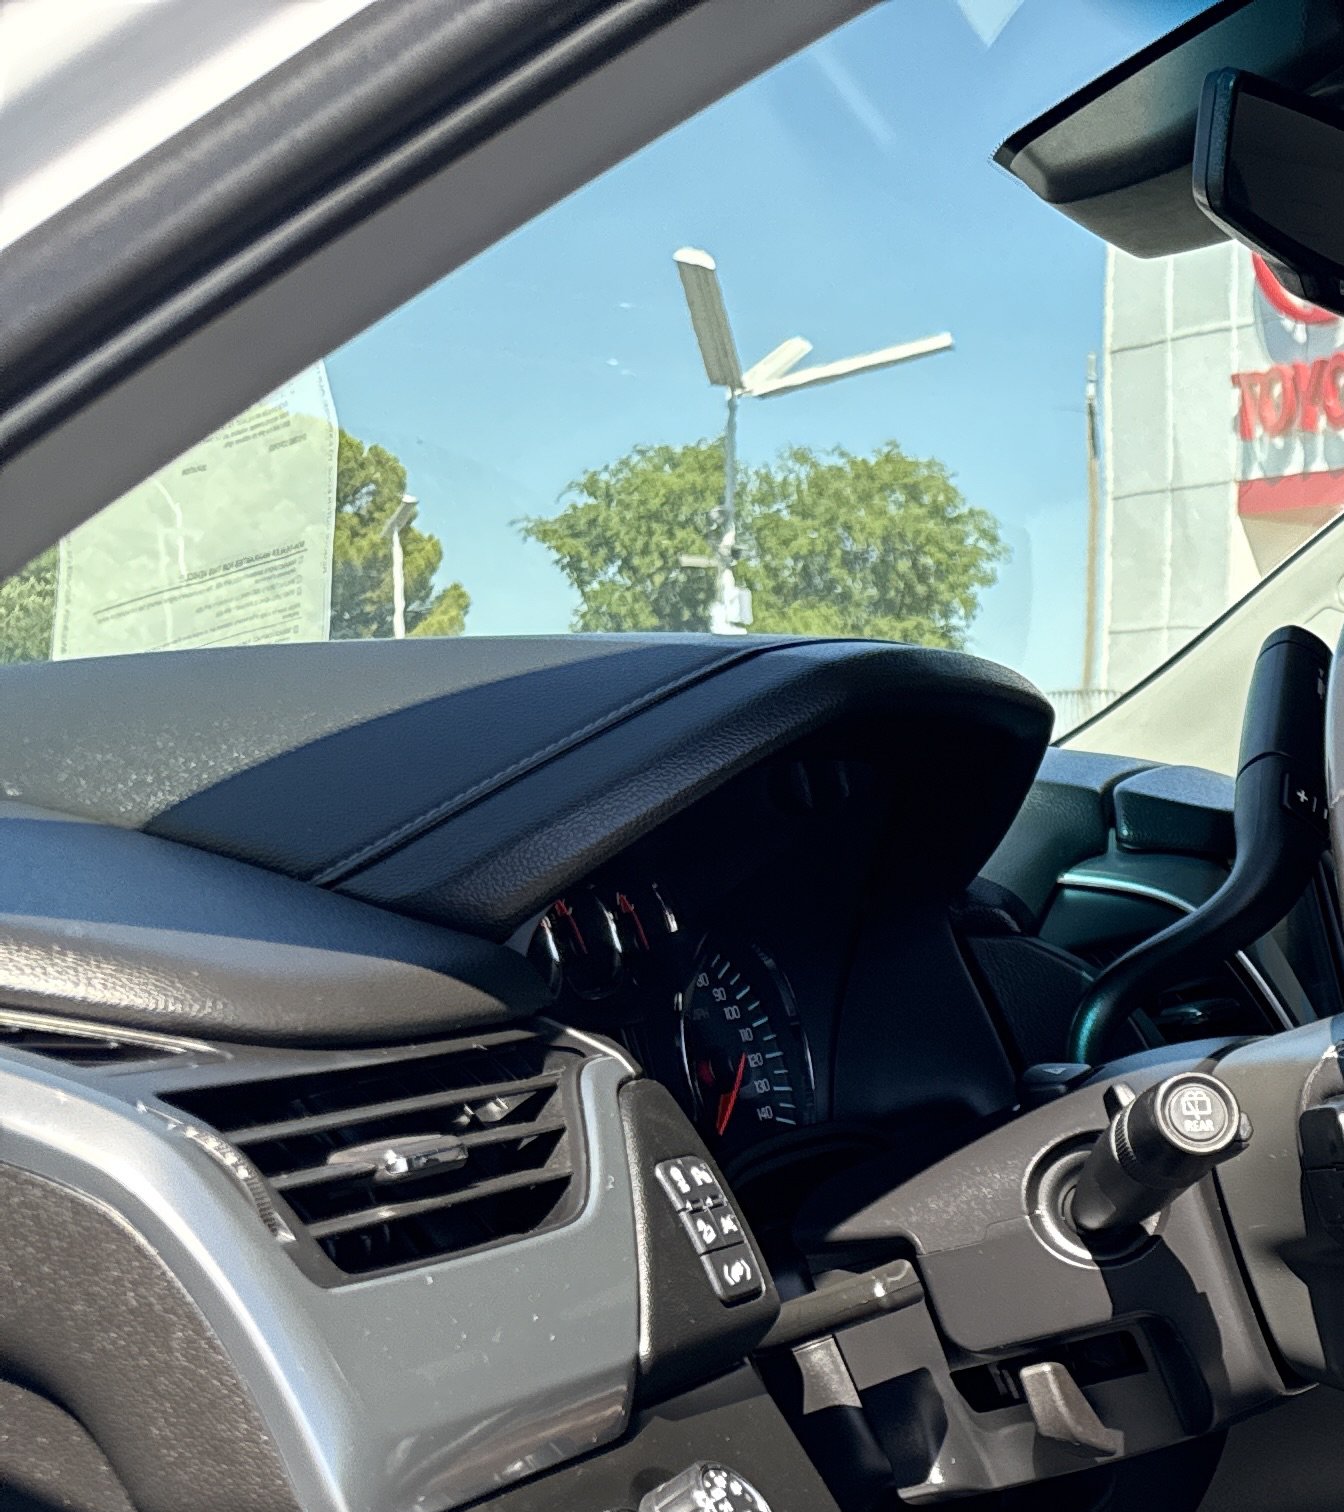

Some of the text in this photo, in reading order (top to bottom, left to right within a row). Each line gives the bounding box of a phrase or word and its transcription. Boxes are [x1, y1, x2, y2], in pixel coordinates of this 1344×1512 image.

[712, 987, 727, 1002] 90
[723, 1005, 741, 1021] 100
[738, 1027, 754, 1043] 110
[747, 1052, 764, 1068] 120
[754, 1078, 770, 1094] 130
[756, 1105, 773, 1121] 140
[1183, 1119, 1214, 1132] REAR
